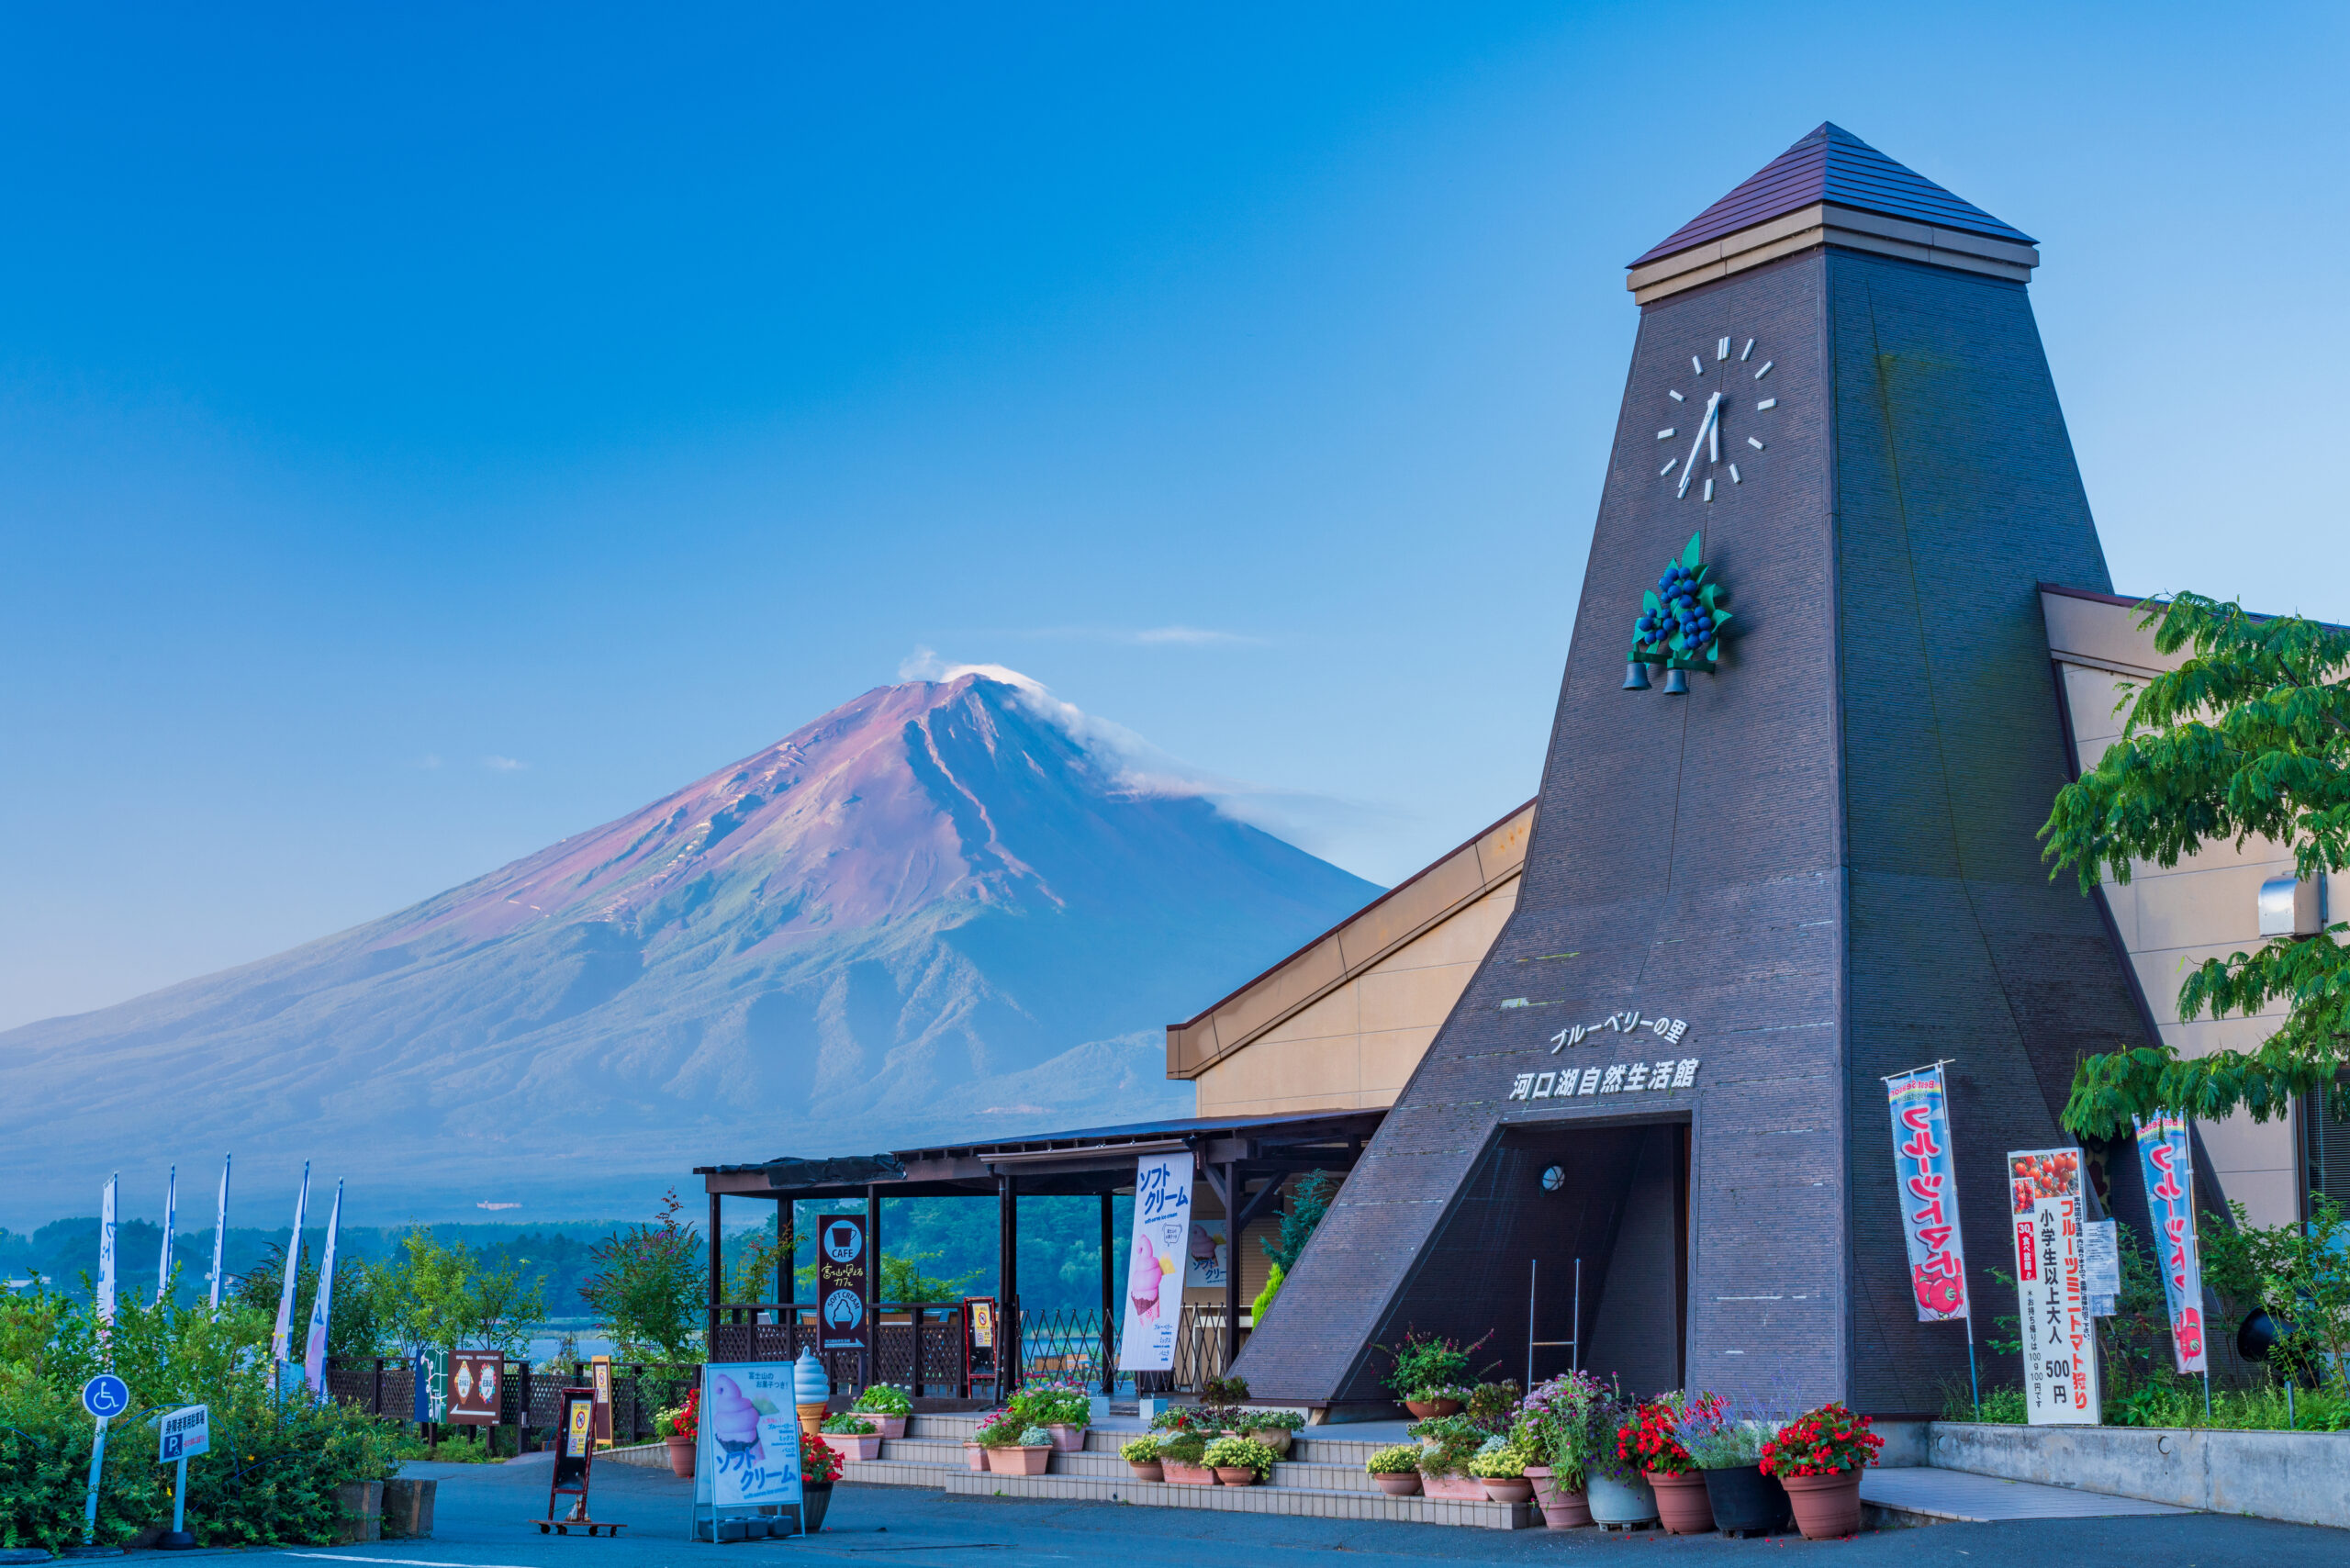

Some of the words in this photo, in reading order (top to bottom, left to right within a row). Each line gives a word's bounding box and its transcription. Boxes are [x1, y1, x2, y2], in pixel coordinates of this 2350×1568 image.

[1550, 1011, 1689, 1055] ブルーベリーの里
[1509, 1058, 1700, 1101] 河口湖自然生活館
[1139, 1163, 1170, 1193] ソフト
[1145, 1185, 1189, 1215] クリーム
[832, 1249, 854, 1258] CAFE
[1192, 1258, 1215, 1271] ソフト
[1205, 1268, 1226, 1280] クリー
[2040, 1208, 2063, 1345] 小学生以上大人
[827, 1292, 842, 1307] SOFT
[842, 1291, 861, 1310] CREAM
[2061, 1200, 2087, 1409] フルーツミニトマト狩り
[169, 1437, 178, 1452] P
[716, 1447, 756, 1473] ソフト
[740, 1465, 797, 1492] クリーム
